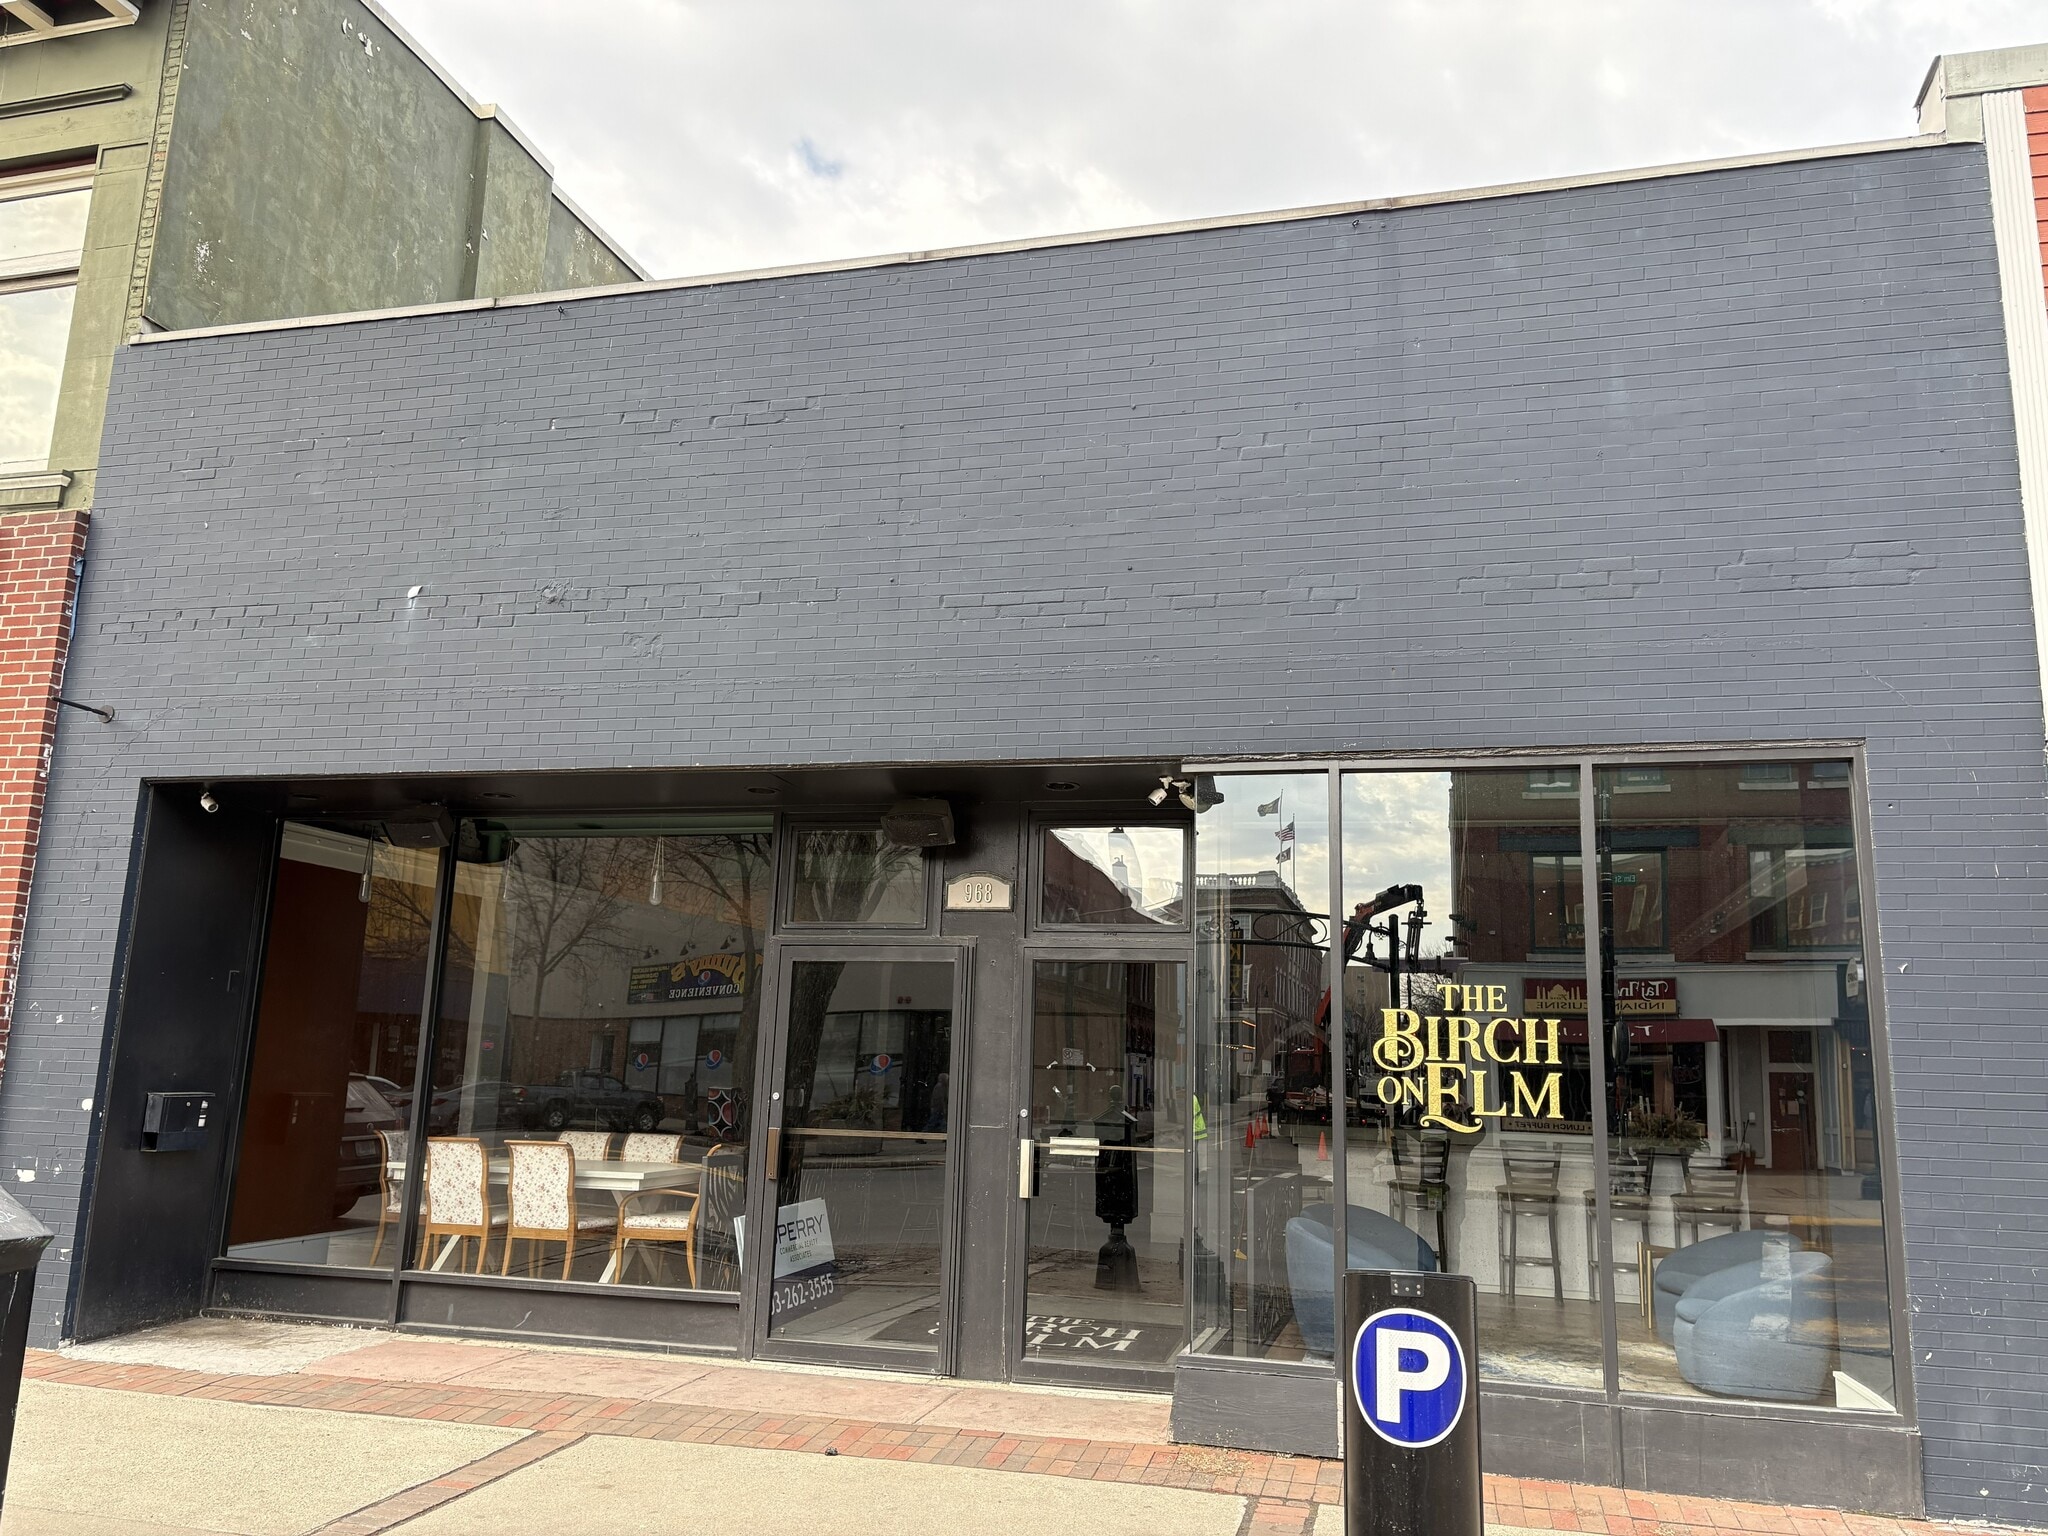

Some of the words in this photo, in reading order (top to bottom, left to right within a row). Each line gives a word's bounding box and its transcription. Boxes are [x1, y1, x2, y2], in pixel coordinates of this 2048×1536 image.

[964, 882, 993, 903] 968
[1436, 984, 1508, 1013] THE
[1373, 1008, 1562, 1072] BIRCH
[1377, 1076, 1425, 1105] ON
[1419, 1062, 1564, 1134] ELM
[776, 1214, 823, 1245] PERRY
[1026, 1321, 1145, 1341] RCH
[1027, 1315, 1096, 1326] THE
[1026, 1333, 1136, 1352] LM
[1376, 1327, 1451, 1424] P
